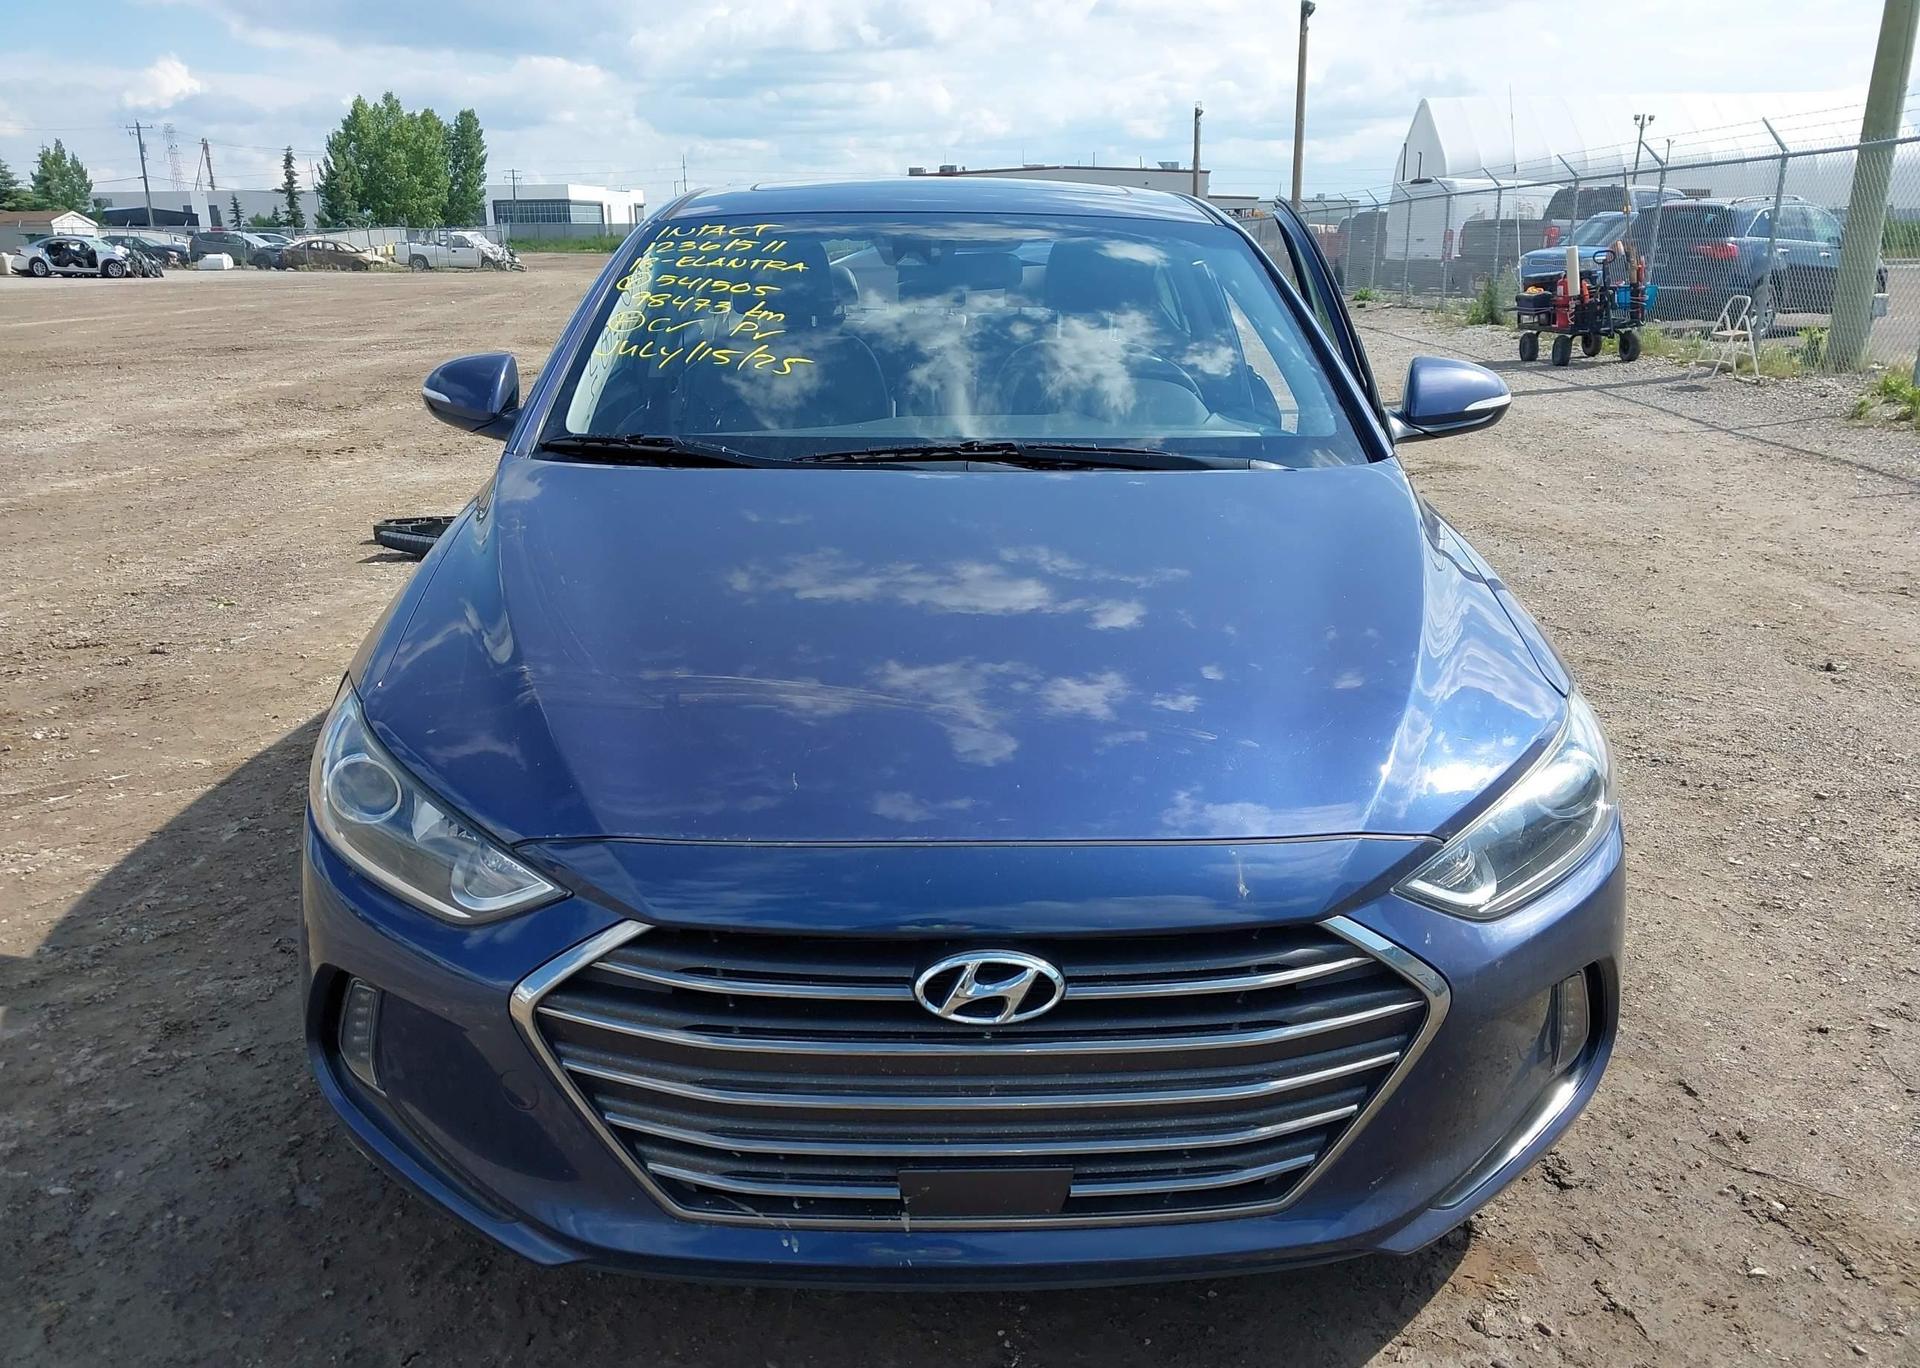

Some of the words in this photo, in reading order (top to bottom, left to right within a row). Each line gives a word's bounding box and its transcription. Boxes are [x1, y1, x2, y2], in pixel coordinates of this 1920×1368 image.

[656, 223, 784, 241] INTACT
[655, 274, 782, 297] 541505
[632, 292, 732, 315] 98473
